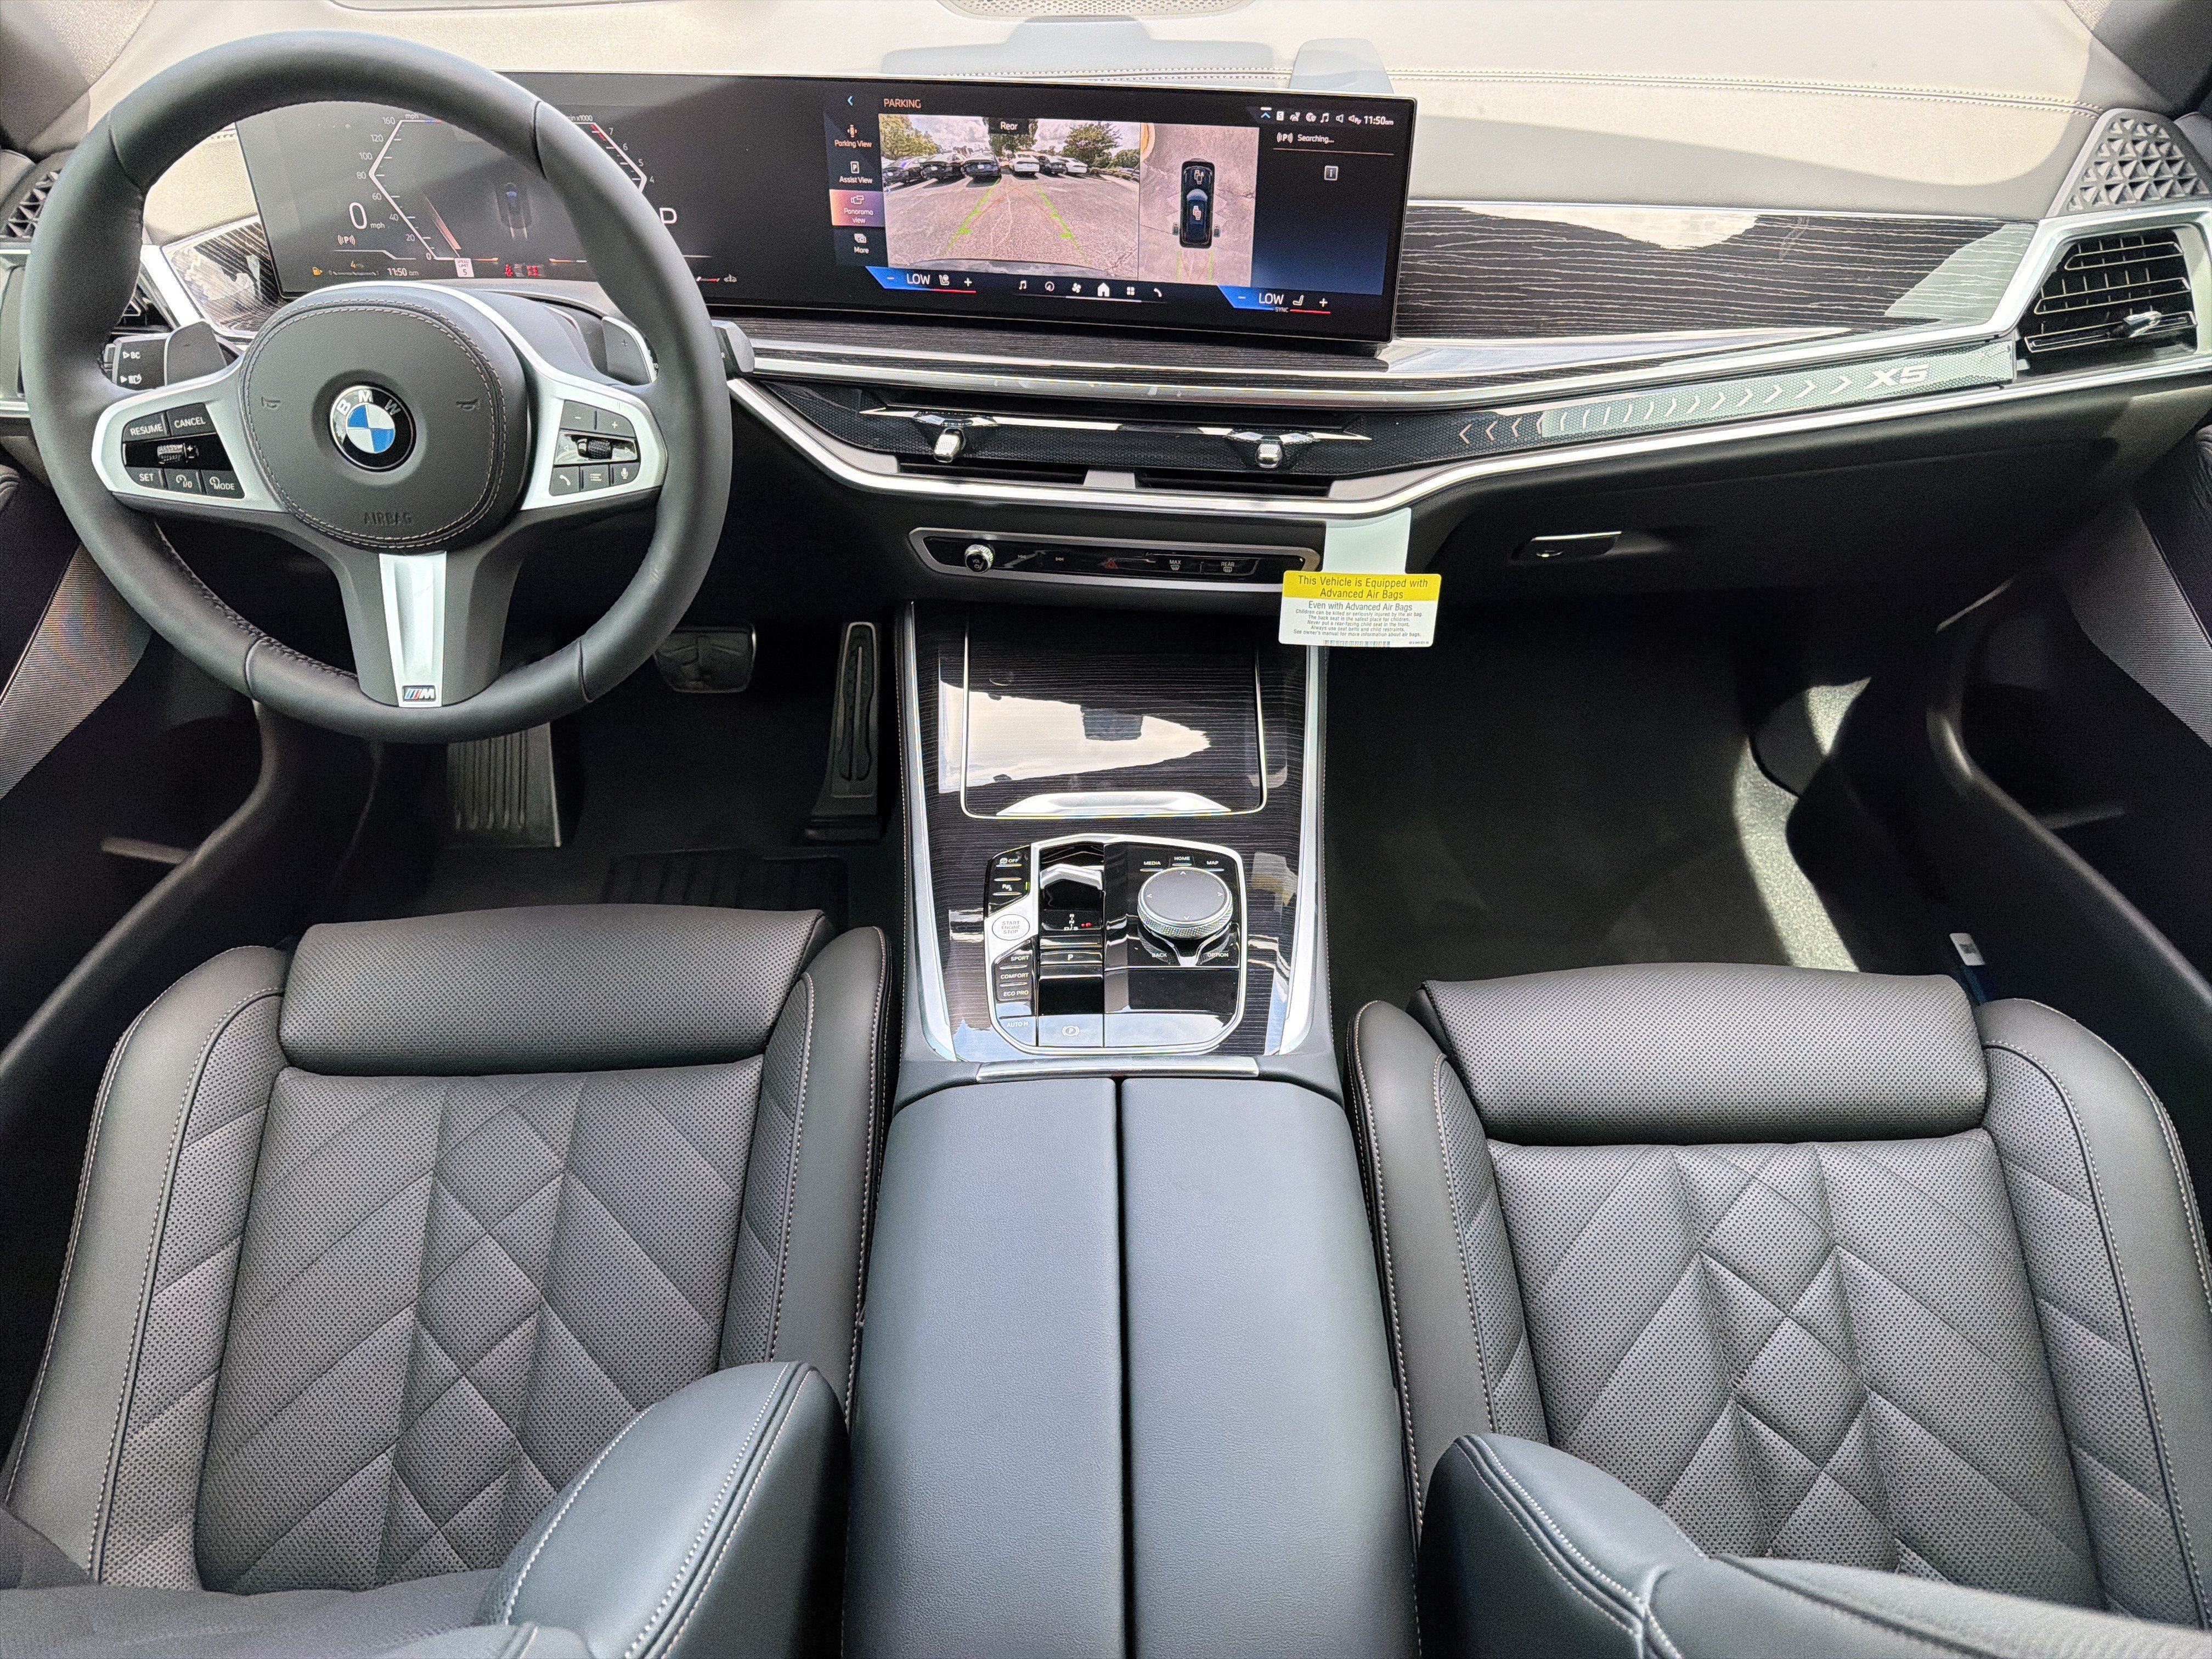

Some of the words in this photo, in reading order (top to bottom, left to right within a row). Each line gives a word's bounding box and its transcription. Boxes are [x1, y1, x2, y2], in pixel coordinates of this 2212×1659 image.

[883, 98, 921, 109] PARKING
[382, 116, 396, 125] 160
[1000, 121, 1019, 131] Rear
[608, 127, 614, 136] 7
[370, 134, 383, 142] 120
[1297, 134, 1334, 144] Searching...
[623, 143, 628, 151] 6
[834, 140, 856, 148] Parking
[359, 152, 373, 160] 100
[638, 159, 644, 167] 5
[356, 171, 366, 179] 80
[649, 176, 654, 184] 4
[372, 192, 382, 201] 60
[349, 202, 368, 229] 0
[659, 207, 678, 224] D
[844, 207, 873, 216] Panorama
[426, 252, 432, 261] 0
[387, 267, 408, 276] 11:50
[906, 273, 930, 285] LOW
[1259, 292, 1284, 305] LOW
[130, 351, 141, 359] BC
[1865, 364, 1929, 389] X5
[336, 389, 402, 416] BMW
[173, 416, 206, 428] CANCEL
[129, 424, 163, 436] RESUME
[139, 473, 154, 482] SET
[364, 511, 413, 526] AIRBAG
[1298, 575, 1317, 585] This
[1319, 577, 1352, 587] Vehicle
[1355, 577, 1362, 587] is
[1365, 578, 1407, 589] Equipped
[1409, 578, 1428, 588] with
[1319, 588, 1364, 599] Advanced
[1365, 589, 1380, 599] Air
[1382, 590, 1404, 601] Bags
[1308, 600, 1326, 610] Even
[1328, 602, 1344, 610] with
[1345, 602, 1381, 611] Advanced
[1383, 603, 1393, 611] Air
[1395, 603, 1413, 612] Bags
